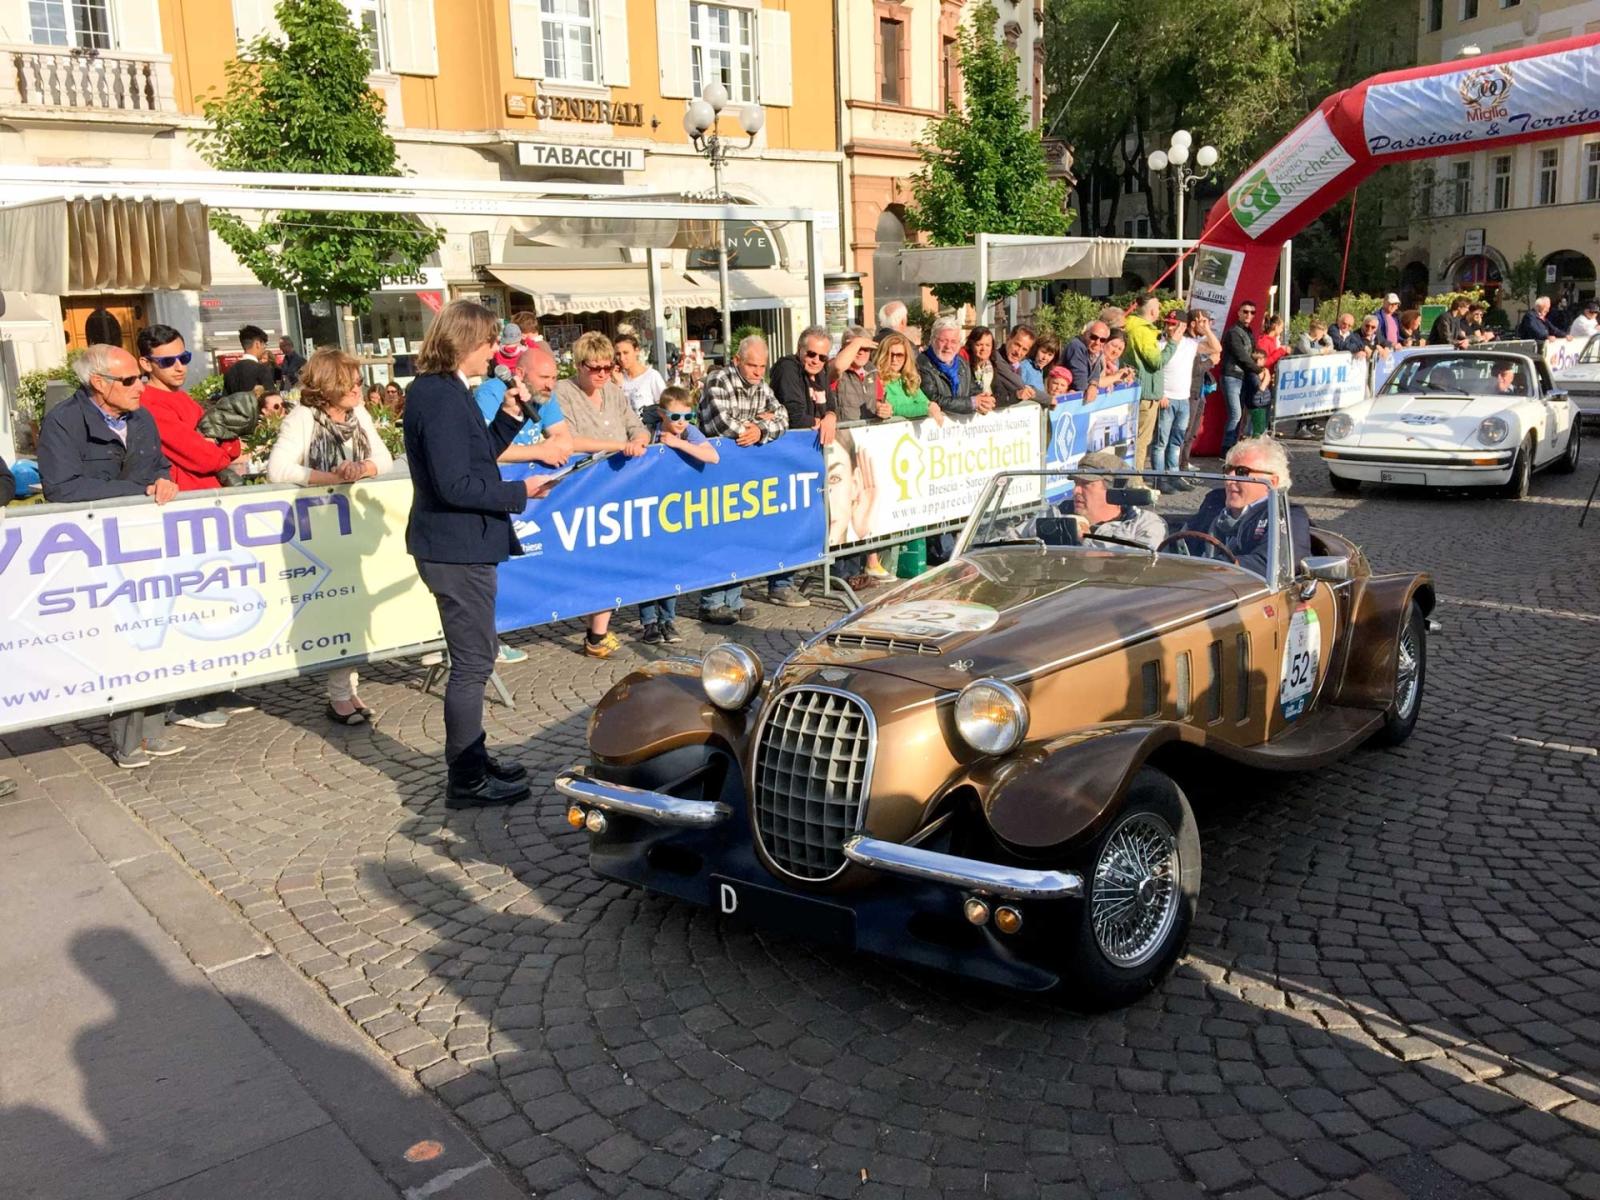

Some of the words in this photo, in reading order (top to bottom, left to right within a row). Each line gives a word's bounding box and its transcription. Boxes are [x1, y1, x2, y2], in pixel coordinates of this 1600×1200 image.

[1466, 106, 1508, 122] Miglia
[1368, 128, 1474, 154] Passione
[1485, 121, 1501, 136] &
[533, 146, 632, 168] TABACCHI
[1279, 141, 1345, 196] Bricchetti
[927, 431, 1032, 480] Bricchetti
[928, 481, 958, 497] Brescia
[551, 472, 819, 551] VISITCHIESE.IT
[38, 562, 267, 616] STAMPATI
[279, 565, 317, 580] SPA
[114, 608, 217, 633] MATERIALI
[229, 599, 268, 614] NON
[280, 585, 357, 605] FERROSI
[890, 609, 956, 624] 52
[1290, 650, 1311, 688] 52
[720, 883, 738, 914] D
